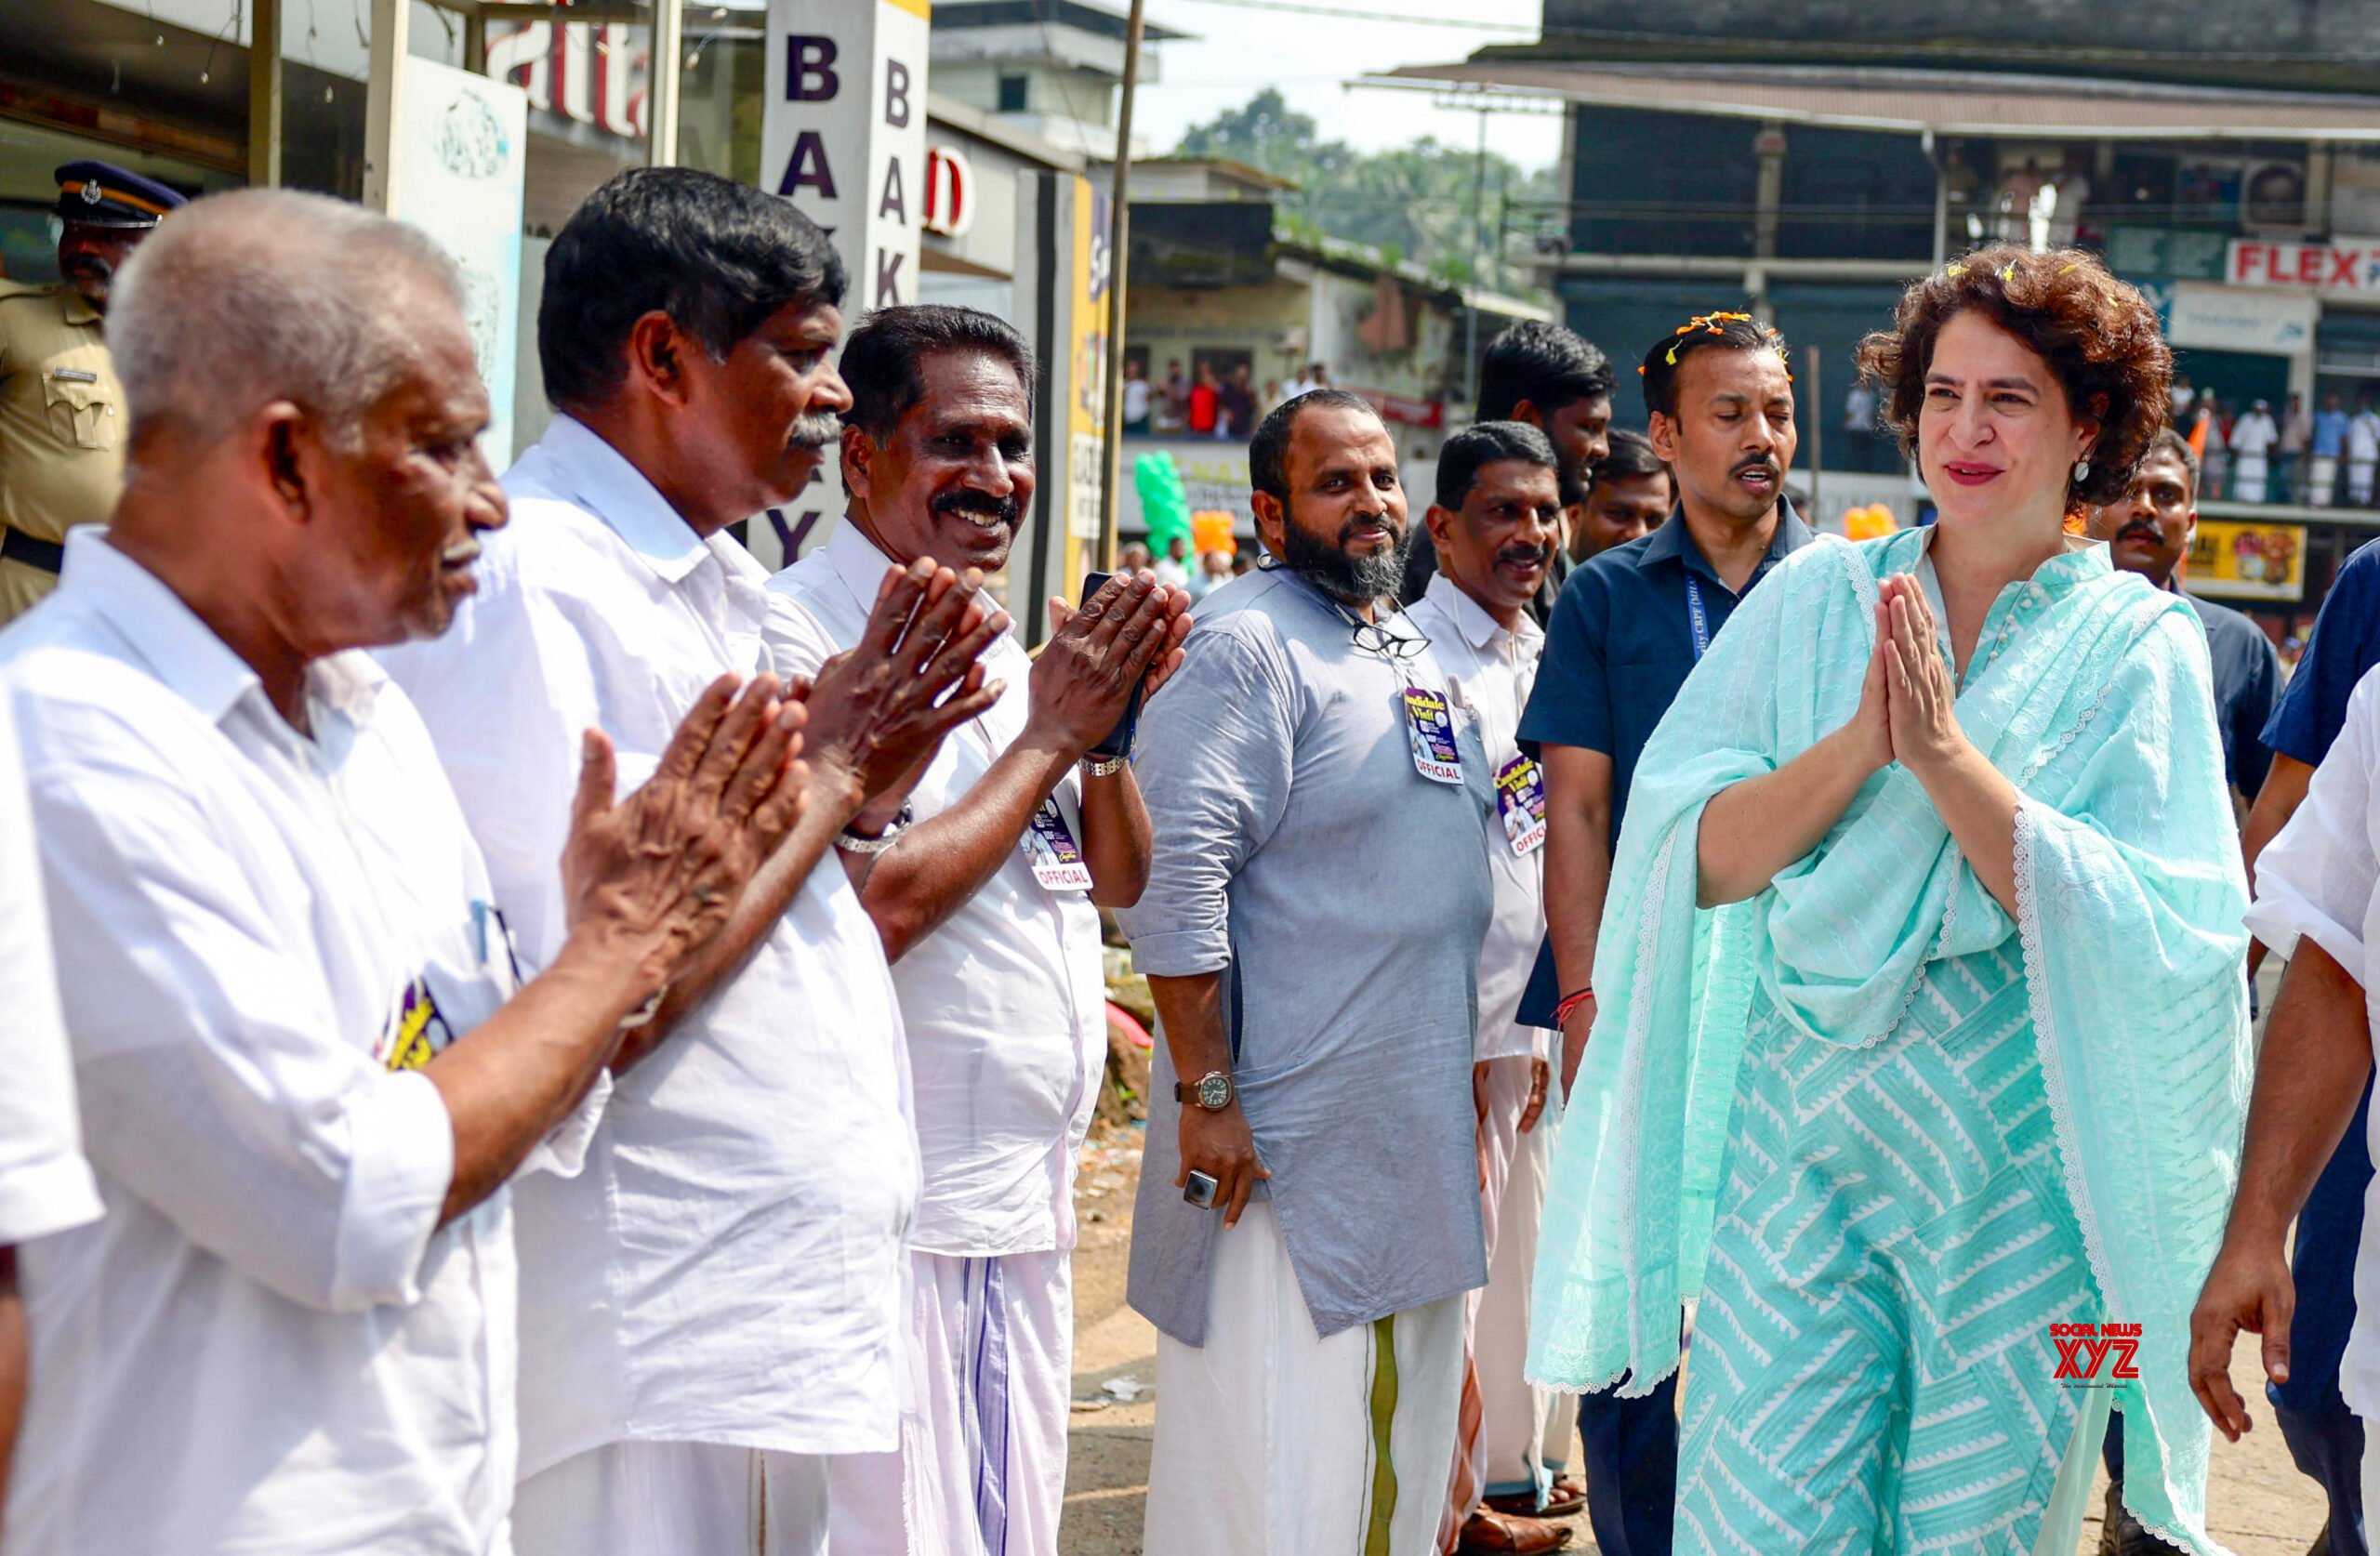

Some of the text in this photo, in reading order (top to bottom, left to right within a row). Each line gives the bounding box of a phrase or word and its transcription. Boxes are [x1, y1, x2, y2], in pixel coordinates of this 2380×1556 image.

[2235, 243, 2361, 288] FLEX
[766, 34, 840, 569] BAY
[1692, 608, 1705, 634] CRPF
[1418, 759, 1461, 779] OFFICIAL
[1038, 870, 1089, 885] OFFICIAL
